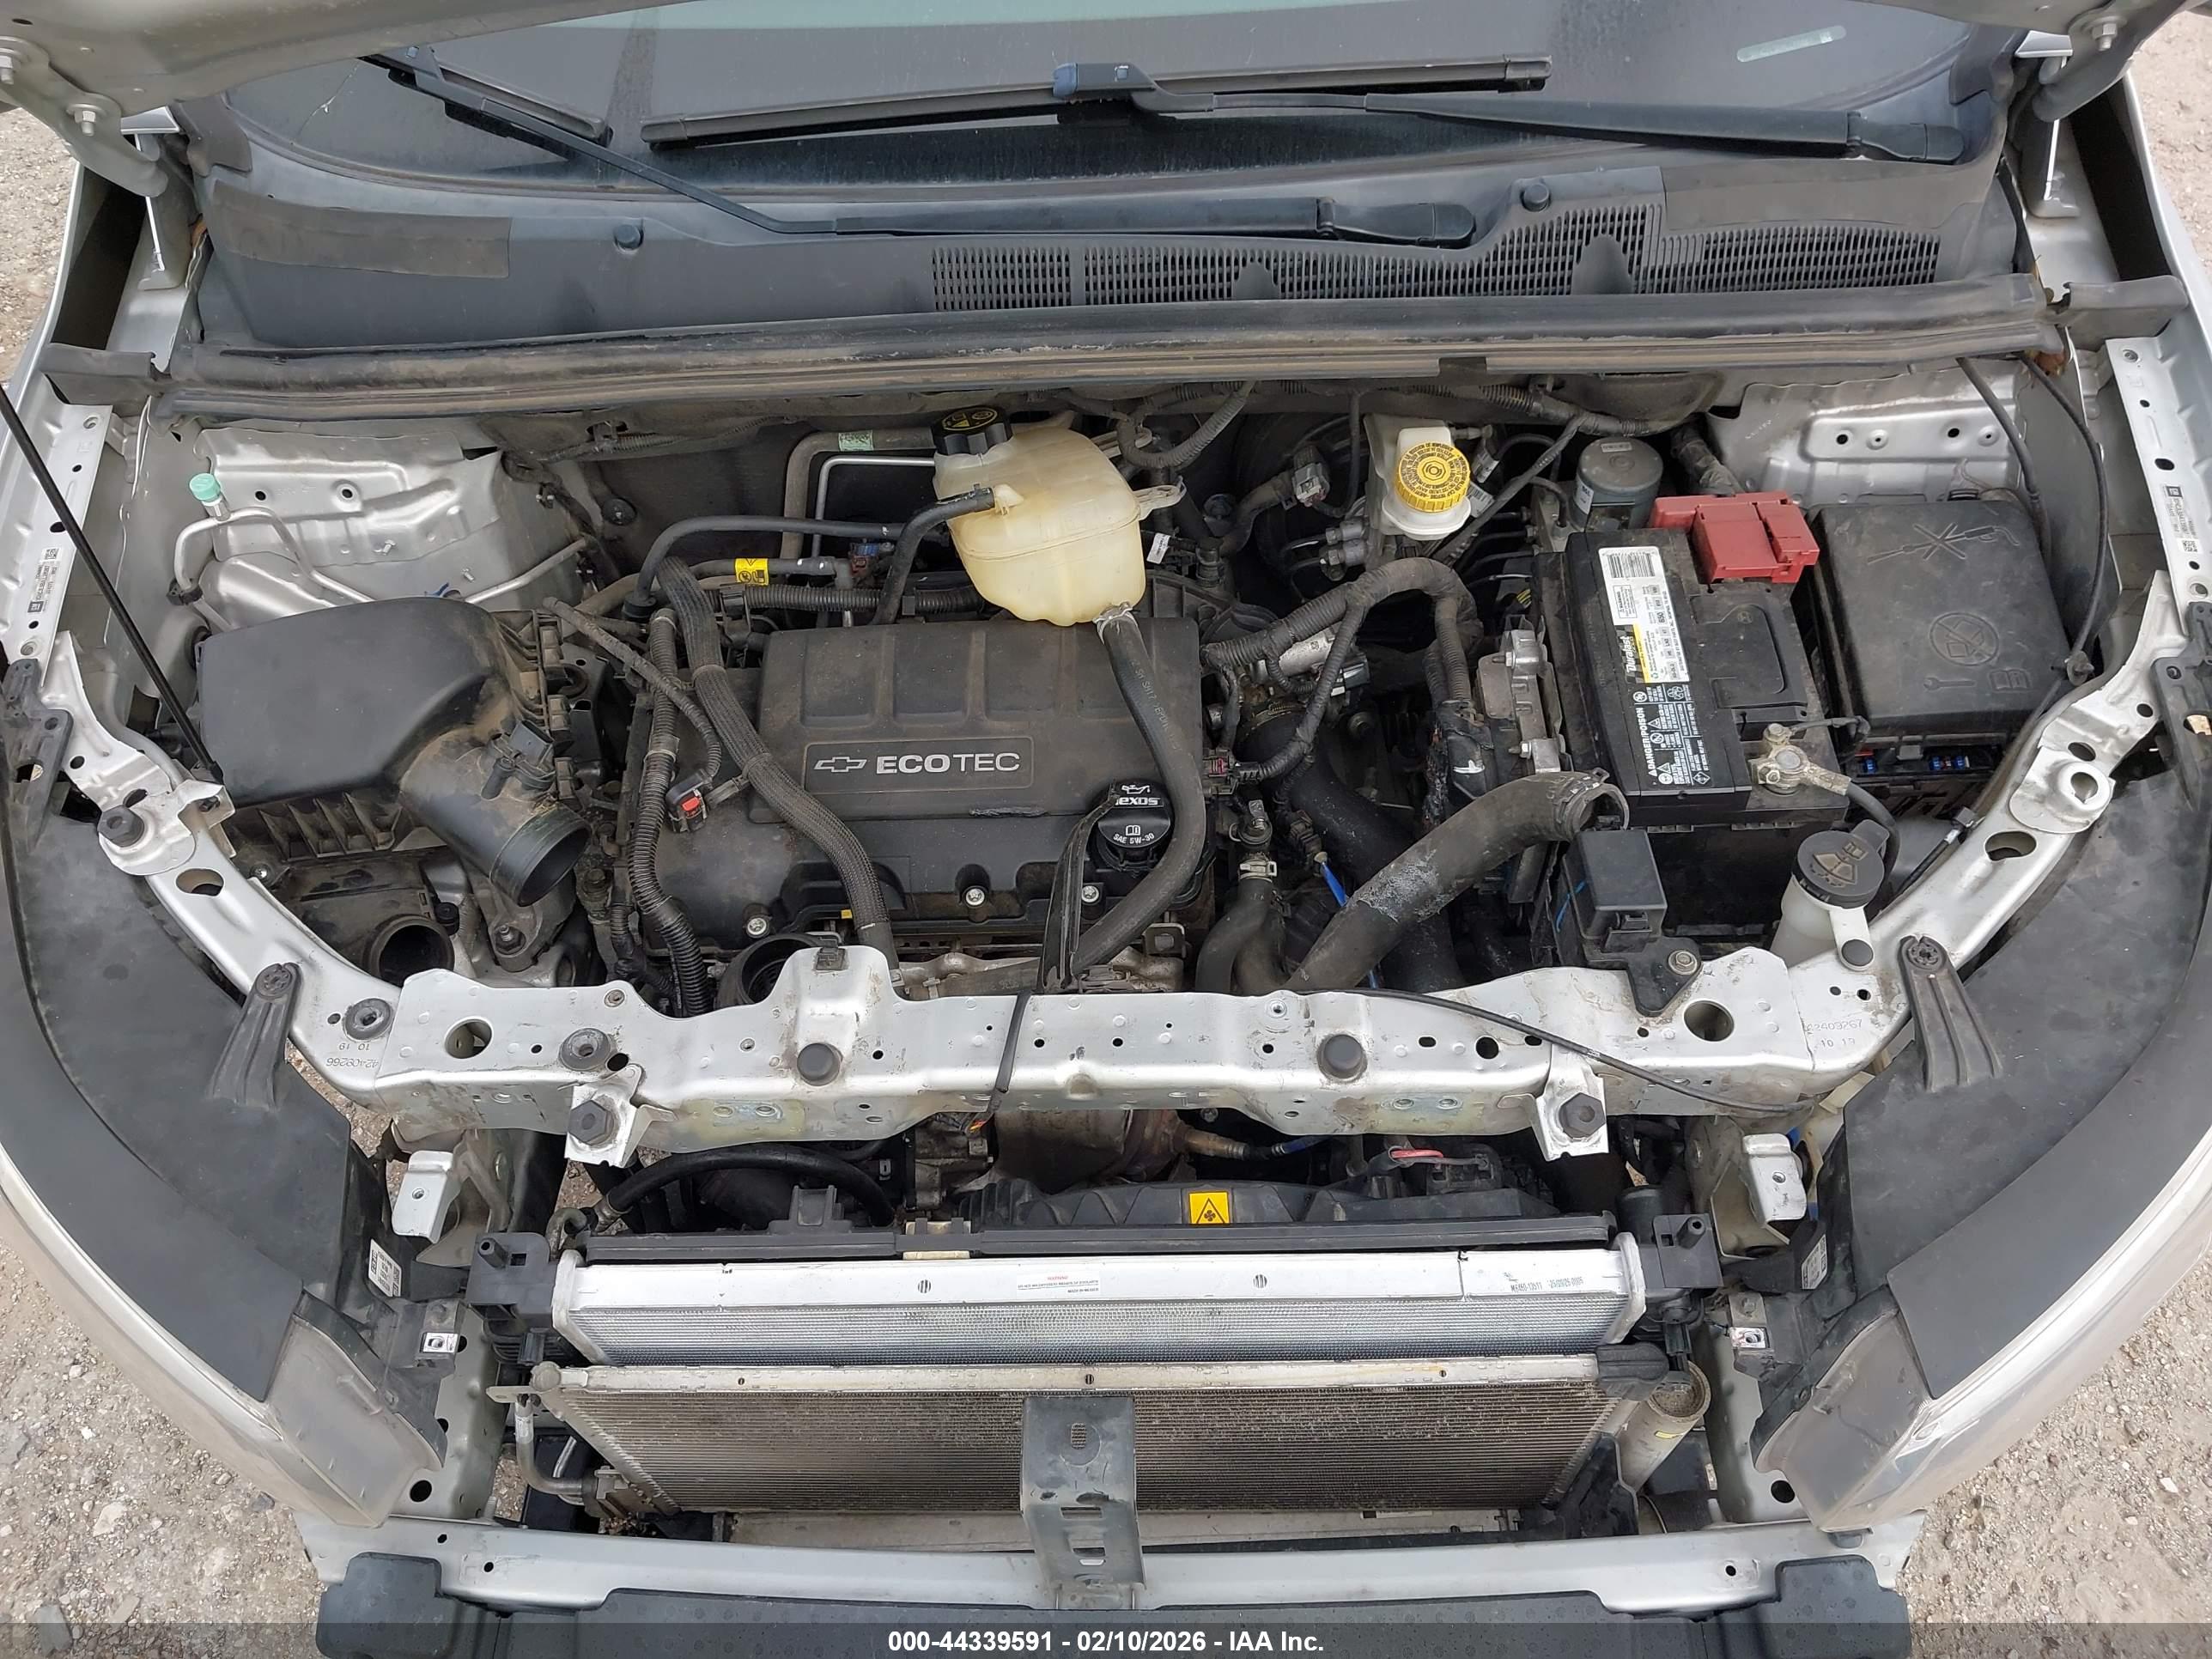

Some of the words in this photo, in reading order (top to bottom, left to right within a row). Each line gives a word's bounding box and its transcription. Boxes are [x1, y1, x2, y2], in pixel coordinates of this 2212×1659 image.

[1656, 611, 1665, 623] 650
[1620, 635, 1637, 672] Duralast
[1635, 707, 1656, 770] DANGER/POISON
[876, 751, 1020, 775] ECOTEC
[1113, 834, 1127, 843] SAE
[1130, 833, 1154, 844] 5W-30
